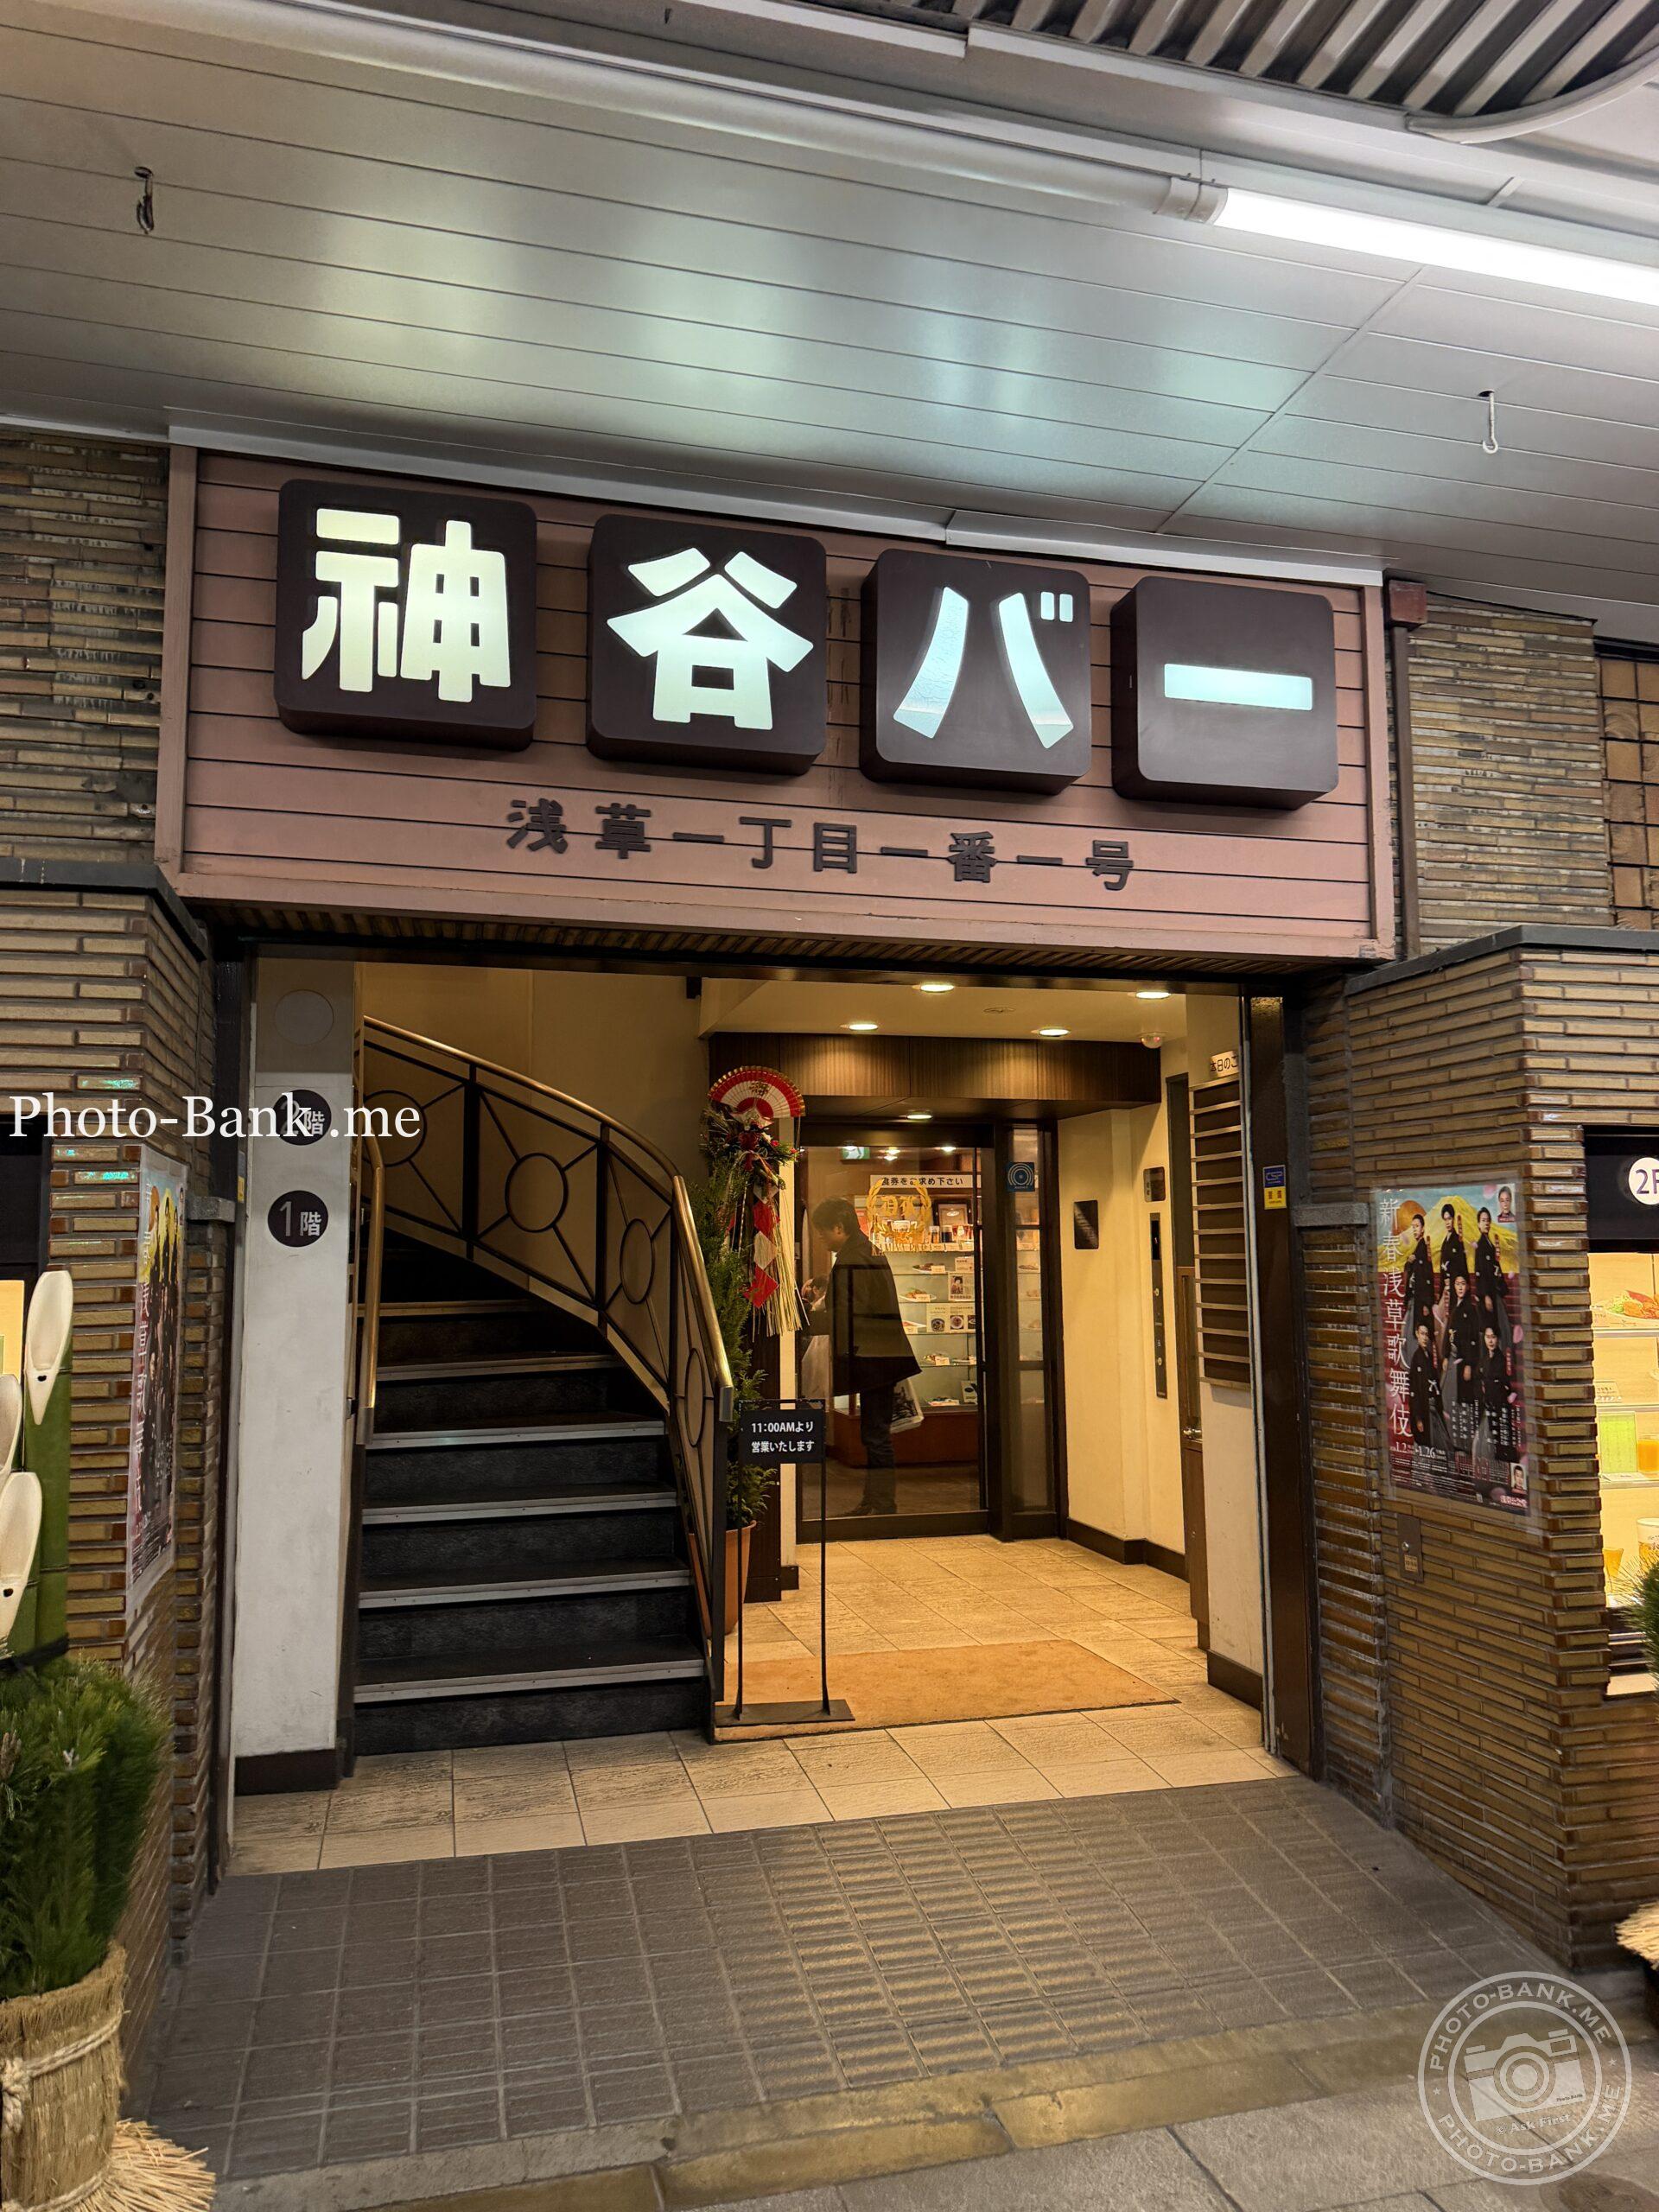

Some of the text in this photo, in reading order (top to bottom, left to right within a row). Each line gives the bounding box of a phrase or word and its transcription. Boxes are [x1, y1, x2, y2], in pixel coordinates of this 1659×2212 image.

[302, 508, 1314, 750] 神谷バー
[506, 798, 1134, 891] 浅草一丁目一番一号
[278, 1201, 322, 1237] 1階
[1380, 1198, 1414, 1438] 新春浅草歌舞伎
[751, 1421, 814, 1433] 11:00AMより
[751, 1440, 815, 1453] 営業いたします
